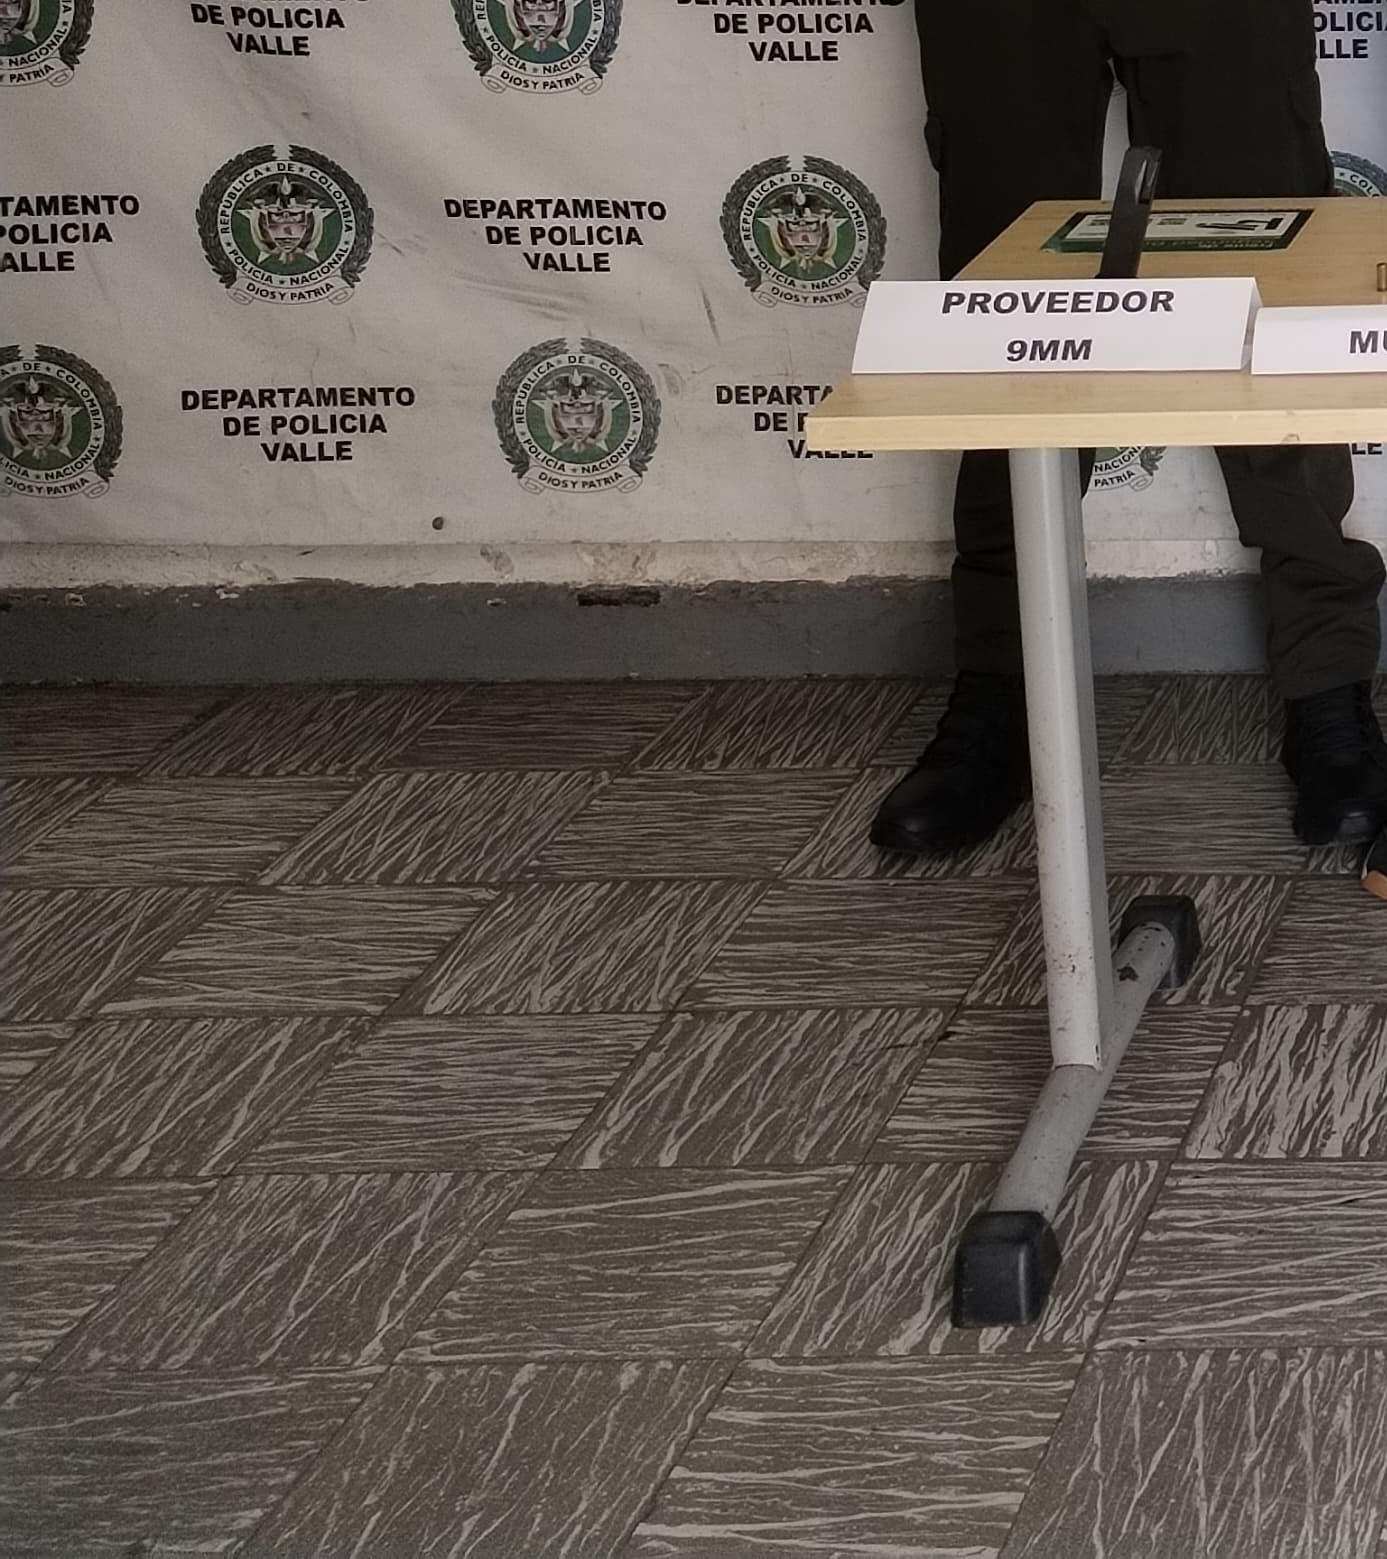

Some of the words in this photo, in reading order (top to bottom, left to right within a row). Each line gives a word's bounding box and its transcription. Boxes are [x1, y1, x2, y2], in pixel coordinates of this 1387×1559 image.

[191, 3, 225, 27] DE
[232, 6, 346, 30] POLICIA
[713, 12, 749, 35] DE
[757, 12, 875, 34] POLICIA
[225, 31, 311, 57] VALLE
[748, 40, 839, 62] VALLE
[443, 198, 667, 221] DEPARTAMENTO
[484, 225, 522, 246] DE
[529, 225, 644, 247] POLICIA
[522, 251, 611, 273] VALLE
[941, 290, 1175, 314] PROVEEDOR
[1006, 338, 1093, 362] 9MM
[181, 386, 416, 411] DEPARTAMENTO
[222, 415, 261, 437] DE
[270, 413, 388, 436] POLICIA
[260, 440, 353, 463] VALLE
